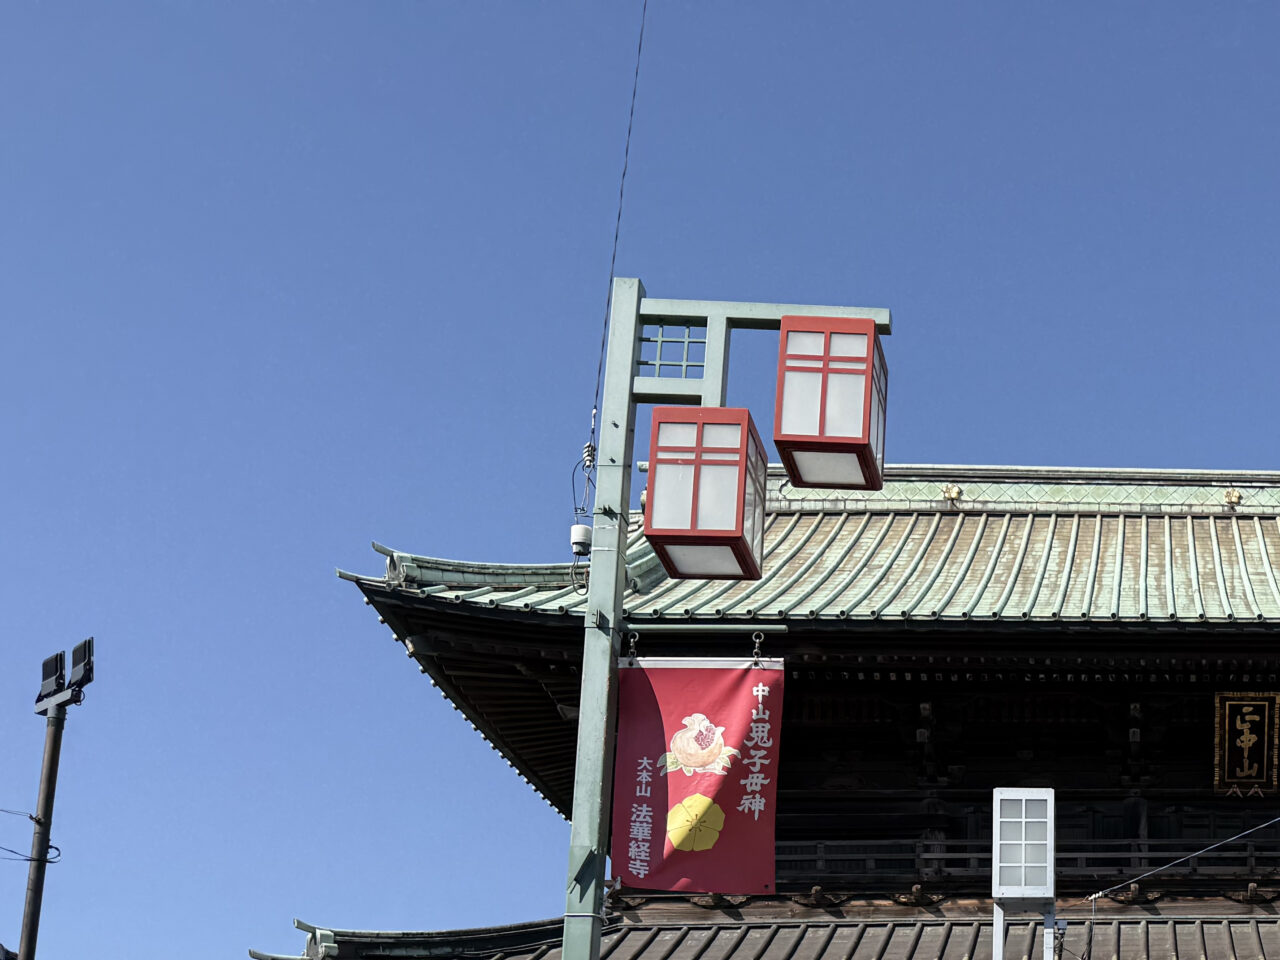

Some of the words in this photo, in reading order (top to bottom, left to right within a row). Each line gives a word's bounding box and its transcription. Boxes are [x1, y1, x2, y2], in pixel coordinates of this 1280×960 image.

[635, 756, 654, 798] 大本山
[628, 803, 654, 879] 法華経寺
